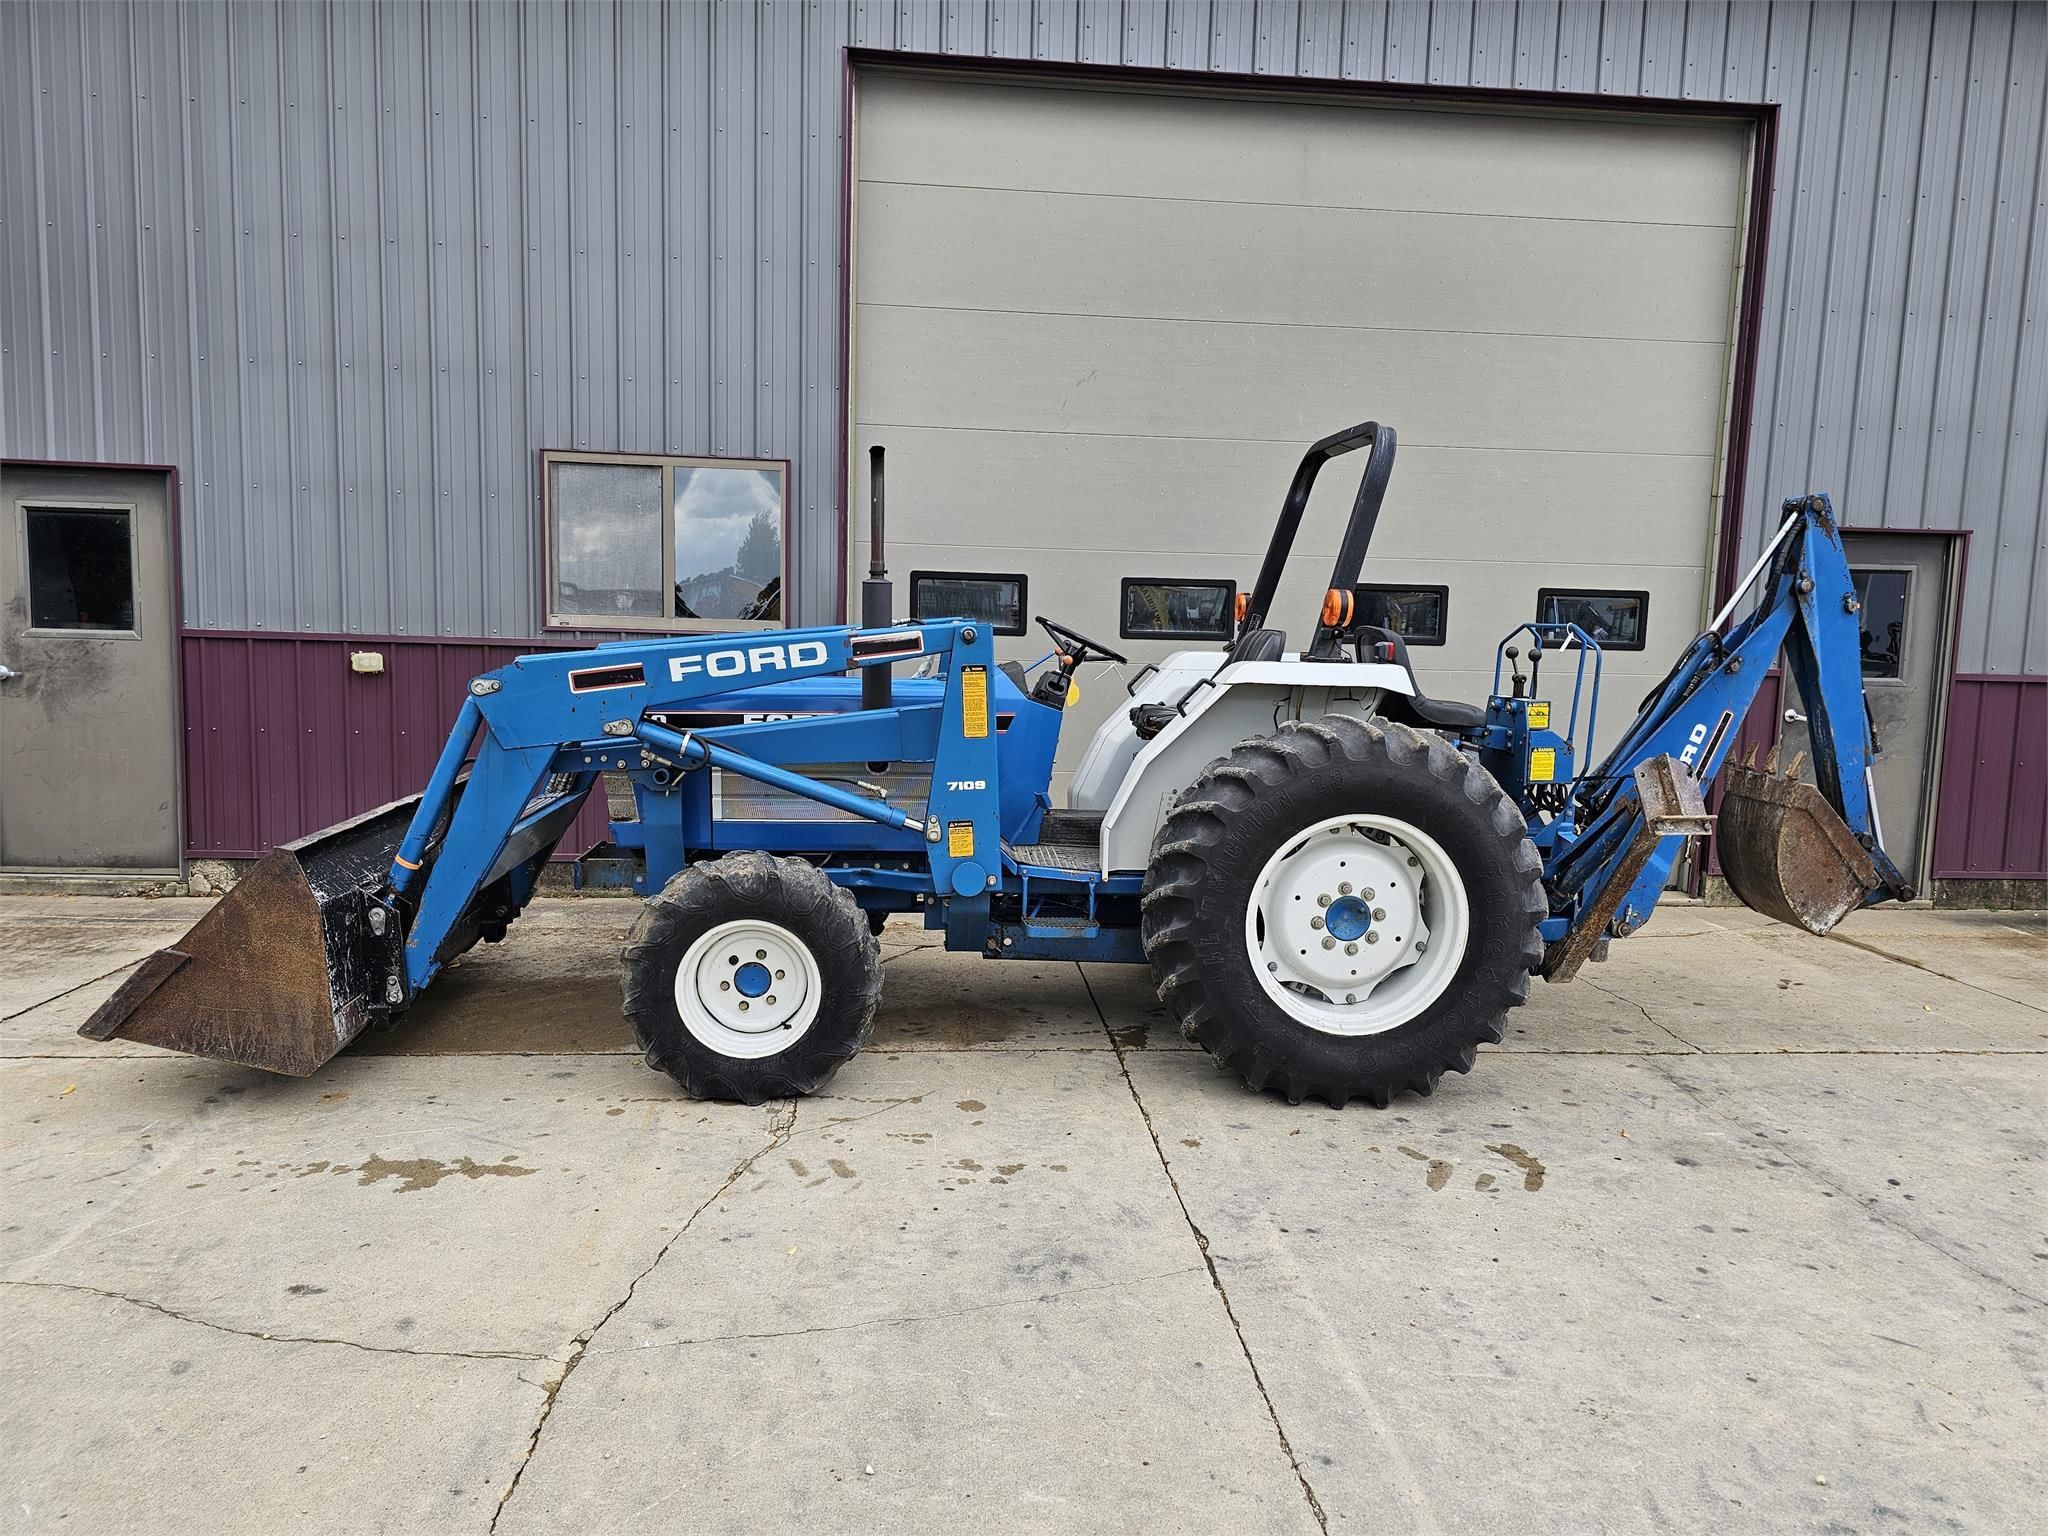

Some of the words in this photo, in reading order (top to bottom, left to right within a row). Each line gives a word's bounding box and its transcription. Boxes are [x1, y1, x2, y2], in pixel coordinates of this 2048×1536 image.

[668, 641, 828, 683] FORD
[1679, 723, 1707, 765] RD
[946, 780, 986, 791] 7109
